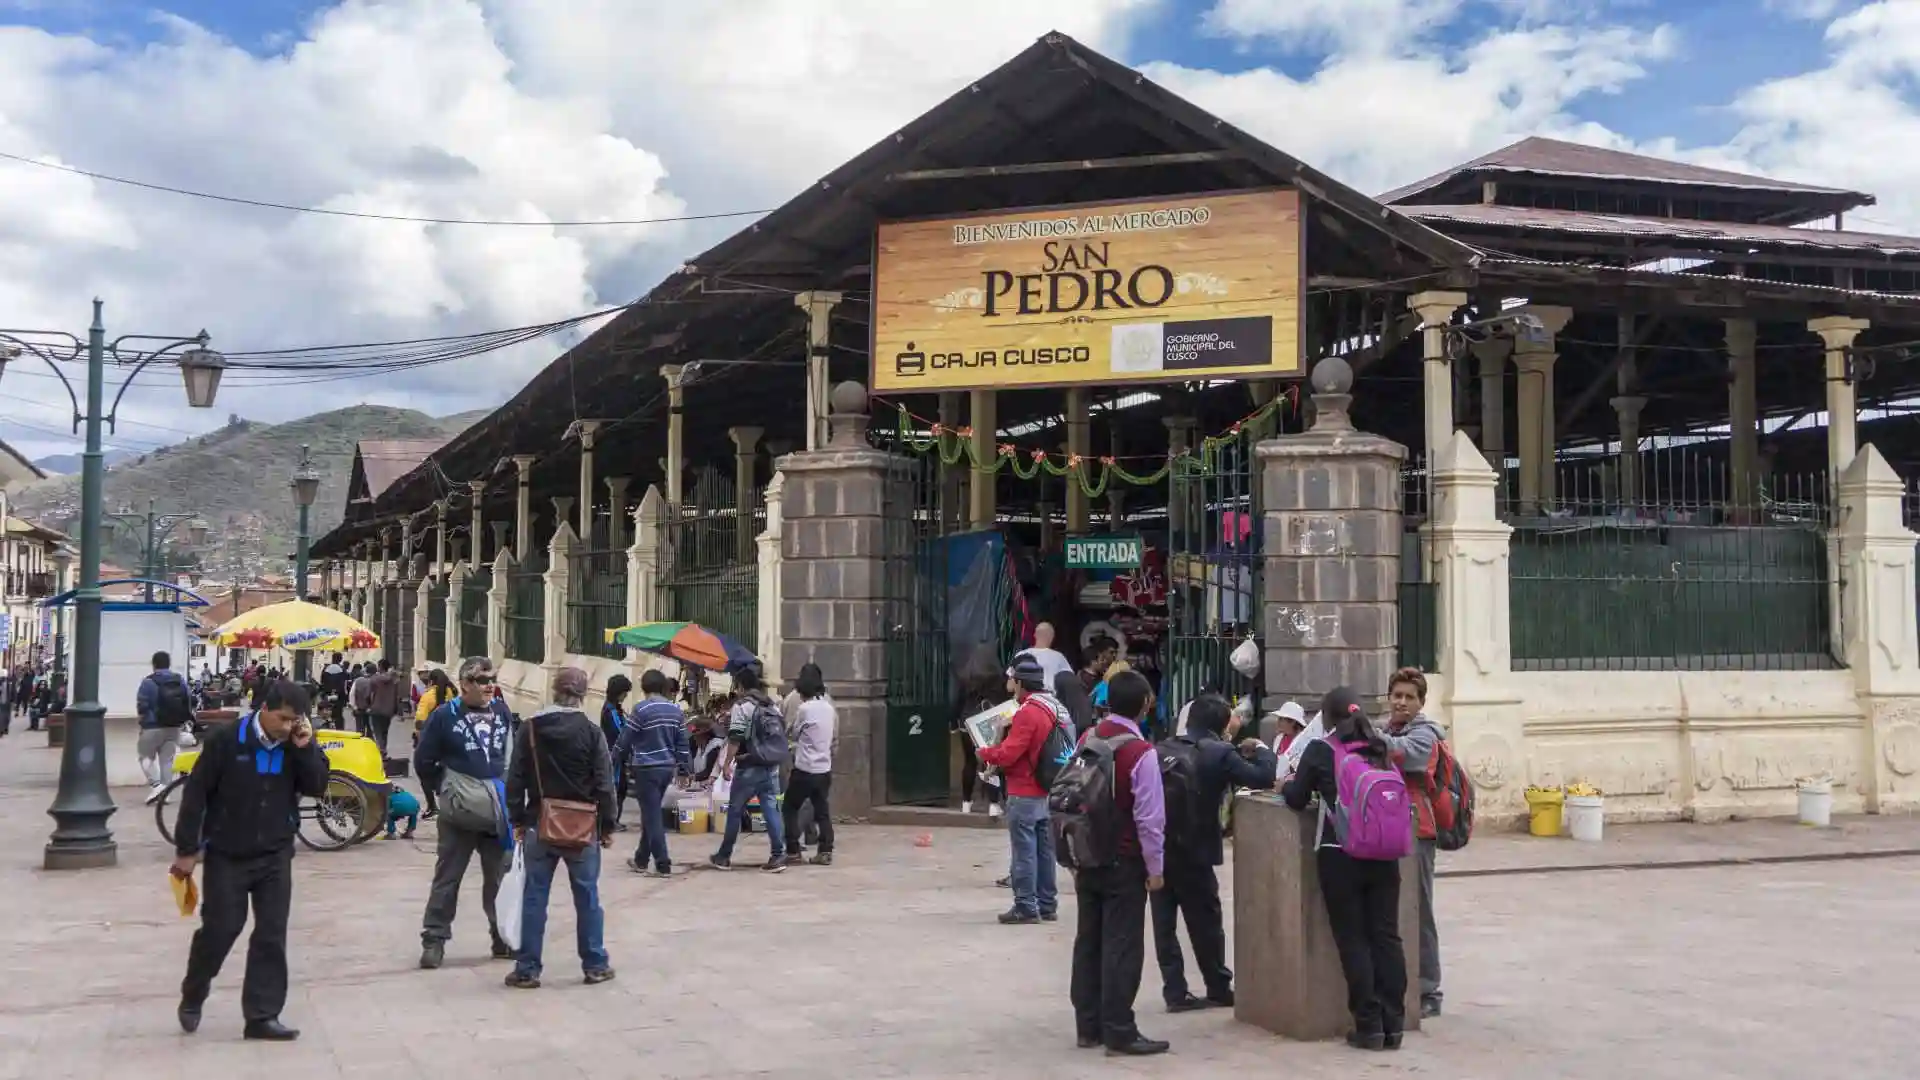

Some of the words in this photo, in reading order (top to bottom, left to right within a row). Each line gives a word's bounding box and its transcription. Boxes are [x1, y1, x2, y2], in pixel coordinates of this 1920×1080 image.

[955, 219, 1078, 243] BIENVENIDOS
[1083, 215, 1106, 233] AL
[1112, 208, 1210, 230] MERCADO
[1042, 241, 1111, 272] SAN
[980, 264, 1175, 318] PEDRO
[1166, 333, 1219, 344] GOBIERNO
[1166, 342, 1217, 353] MUNICIPAL
[1218, 340, 1236, 350] DEL
[931, 352, 997, 369] CAJA
[1004, 346, 1090, 366] CUSCO
[1166, 351, 1198, 361] CUSCO
[1067, 543, 1139, 564] ENTRADA
[909, 715, 922, 735] 2
